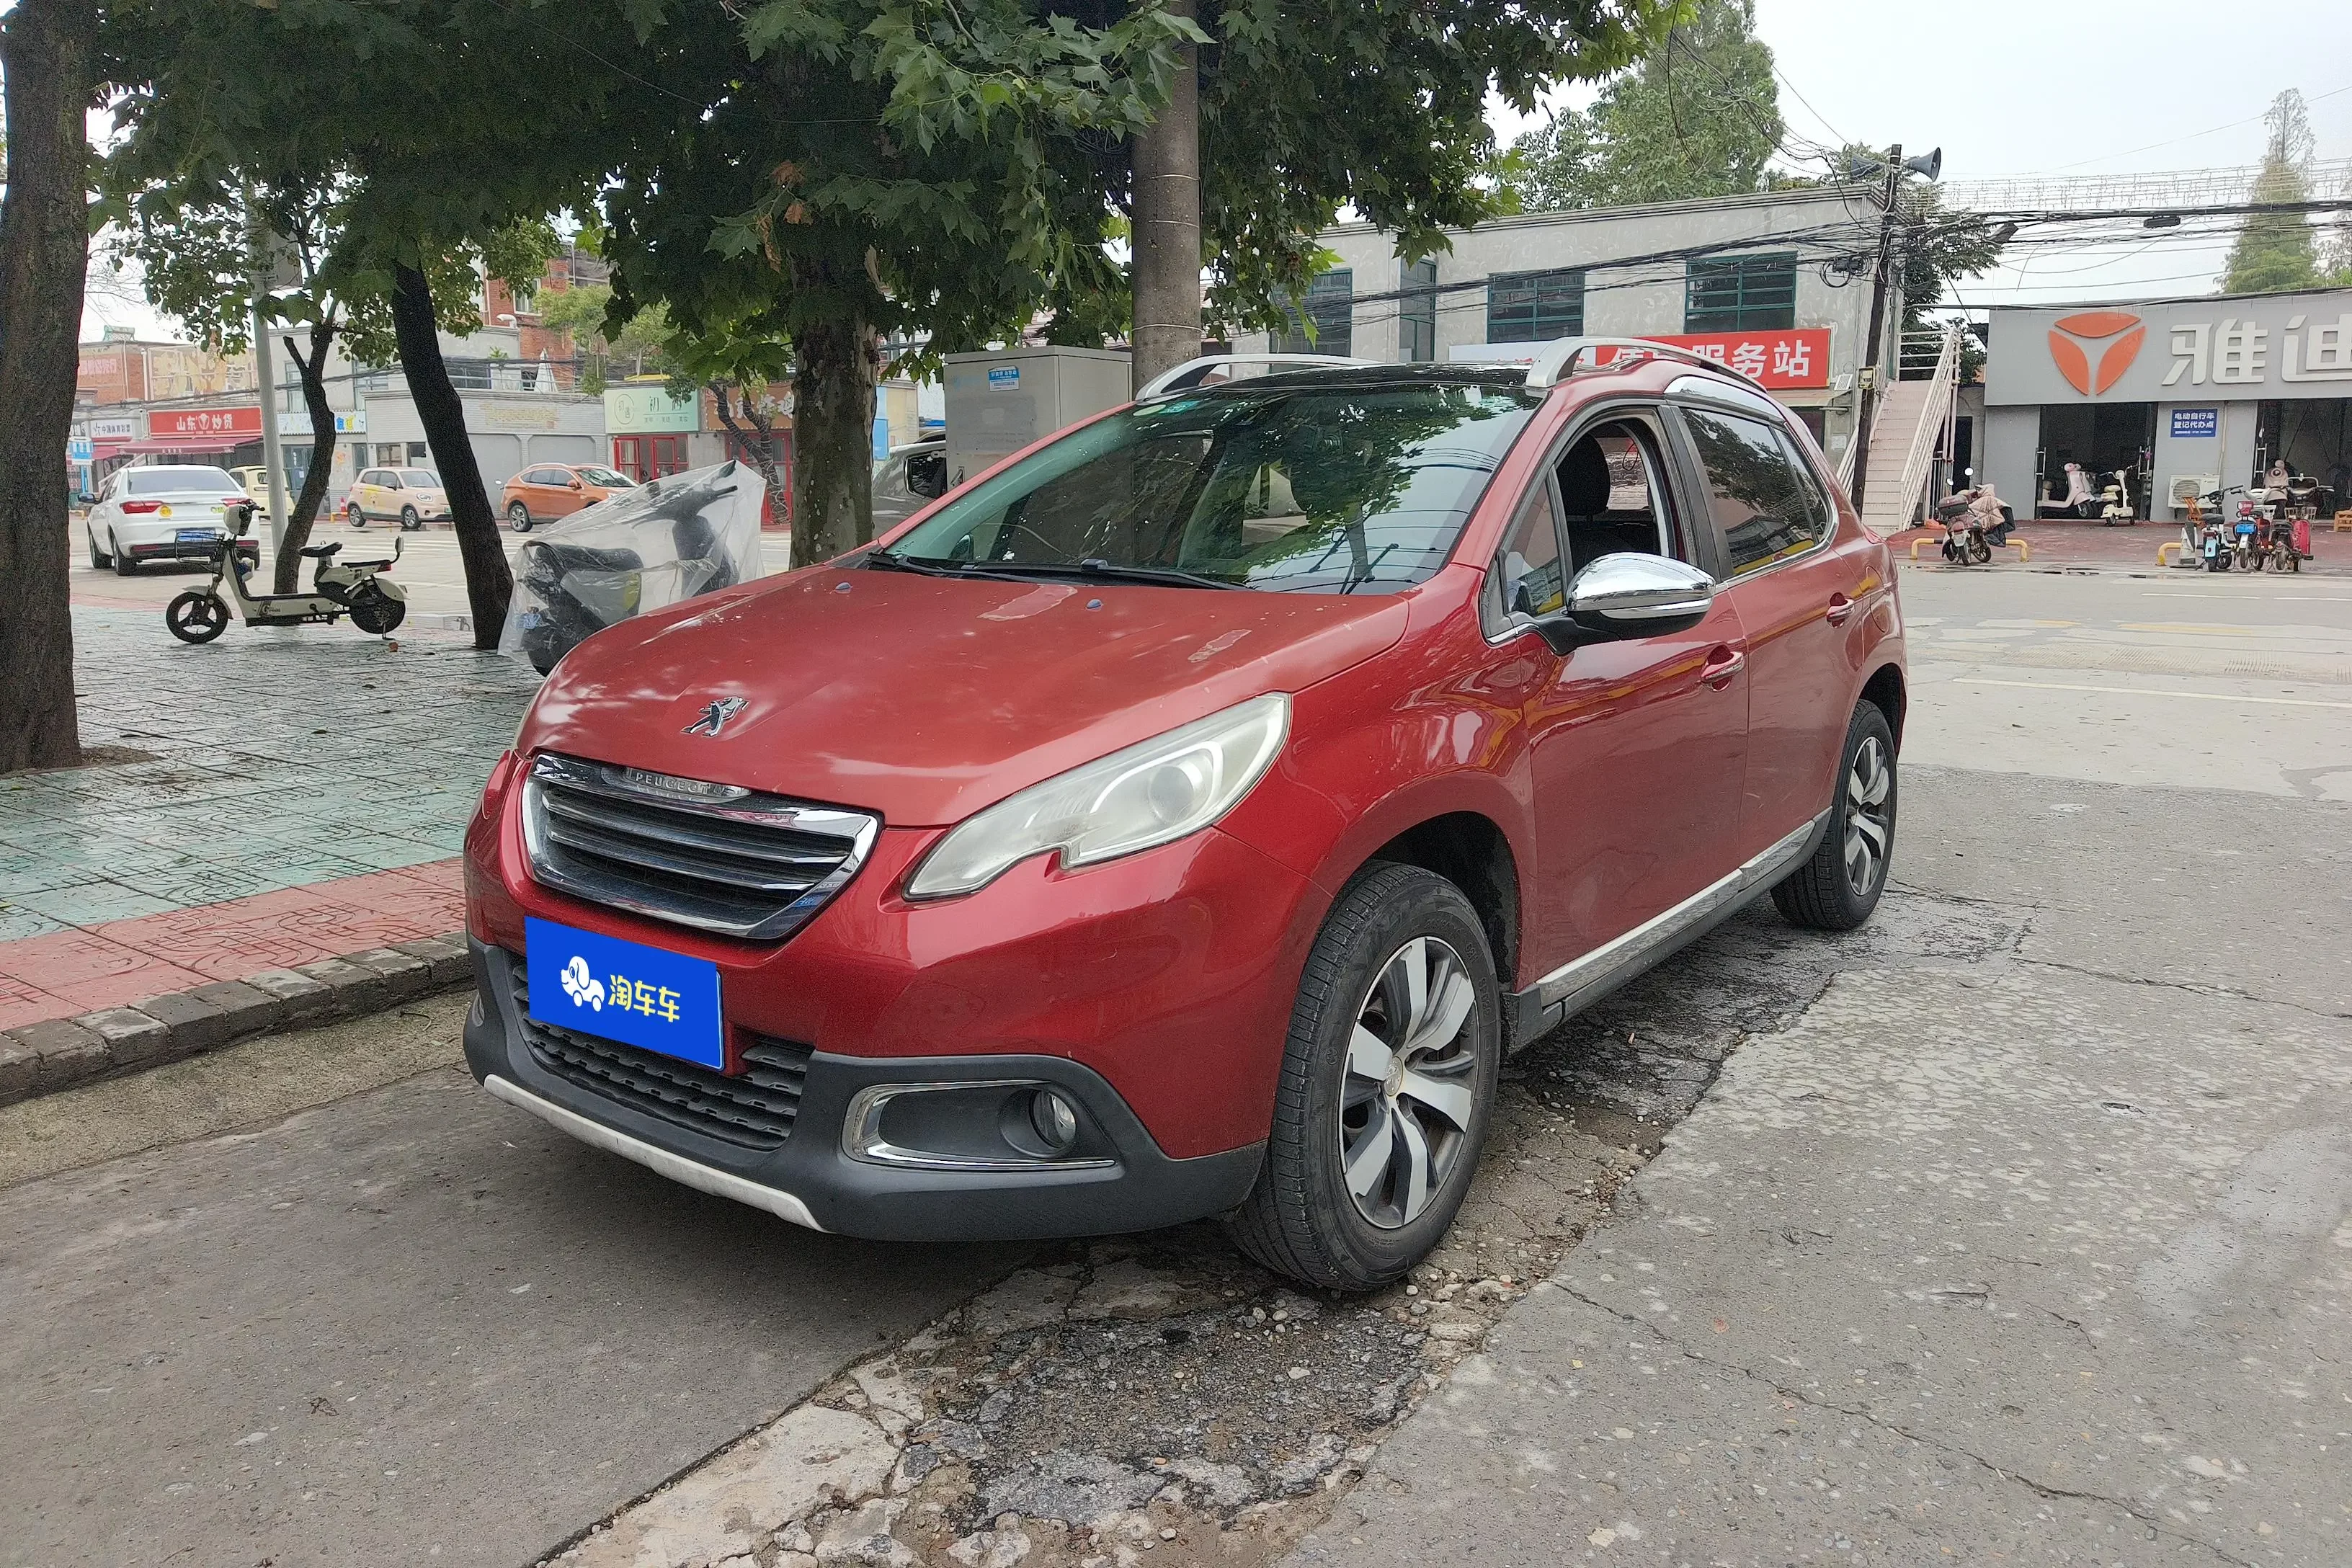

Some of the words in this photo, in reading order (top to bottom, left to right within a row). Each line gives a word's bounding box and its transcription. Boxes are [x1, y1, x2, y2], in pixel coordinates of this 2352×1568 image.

[2162, 314, 2352, 385] 雅迪
[102, 424, 130, 434] 中国体育彩票
[177, 415, 197, 431] 山东
[211, 414, 233, 430] 炒货
[636, 772, 710, 795] PEUGEOT
